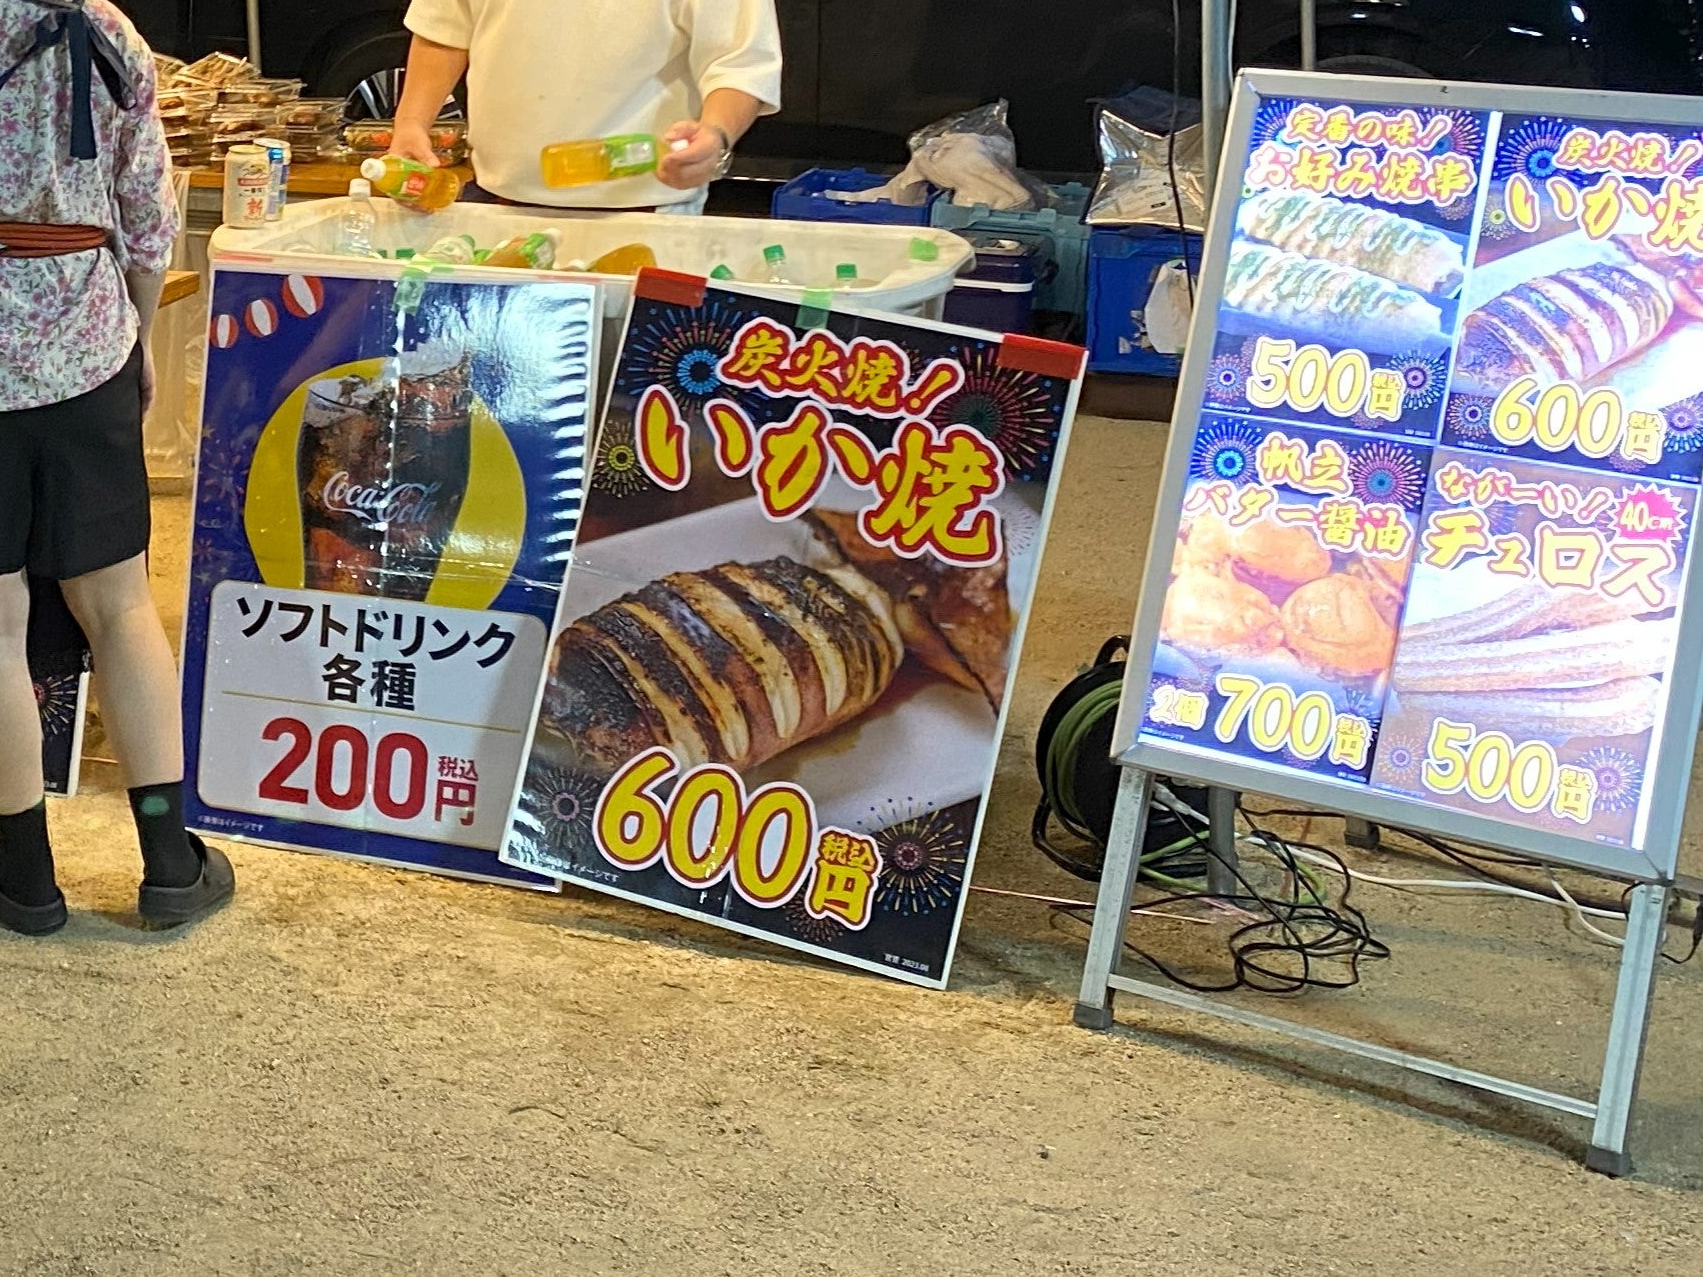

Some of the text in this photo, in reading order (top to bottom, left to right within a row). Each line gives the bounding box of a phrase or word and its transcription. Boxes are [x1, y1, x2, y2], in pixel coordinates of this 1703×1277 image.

[1248, 144, 1475, 202] お好み焼串
[1555, 130, 1699, 175] 炭火焼！
[719, 320, 962, 415] 炭火焼！
[640, 389, 1001, 562] いか焼
[1258, 434, 1350, 495] 帆立
[323, 471, 442, 523] Coca-Cola
[1184, 483, 1412, 555] バター醤油
[1425, 510, 1672, 607] チュロス
[236, 597, 516, 669] ソフトドリンク
[322, 653, 416, 712] 各種
[436, 755, 479, 782] 税込
